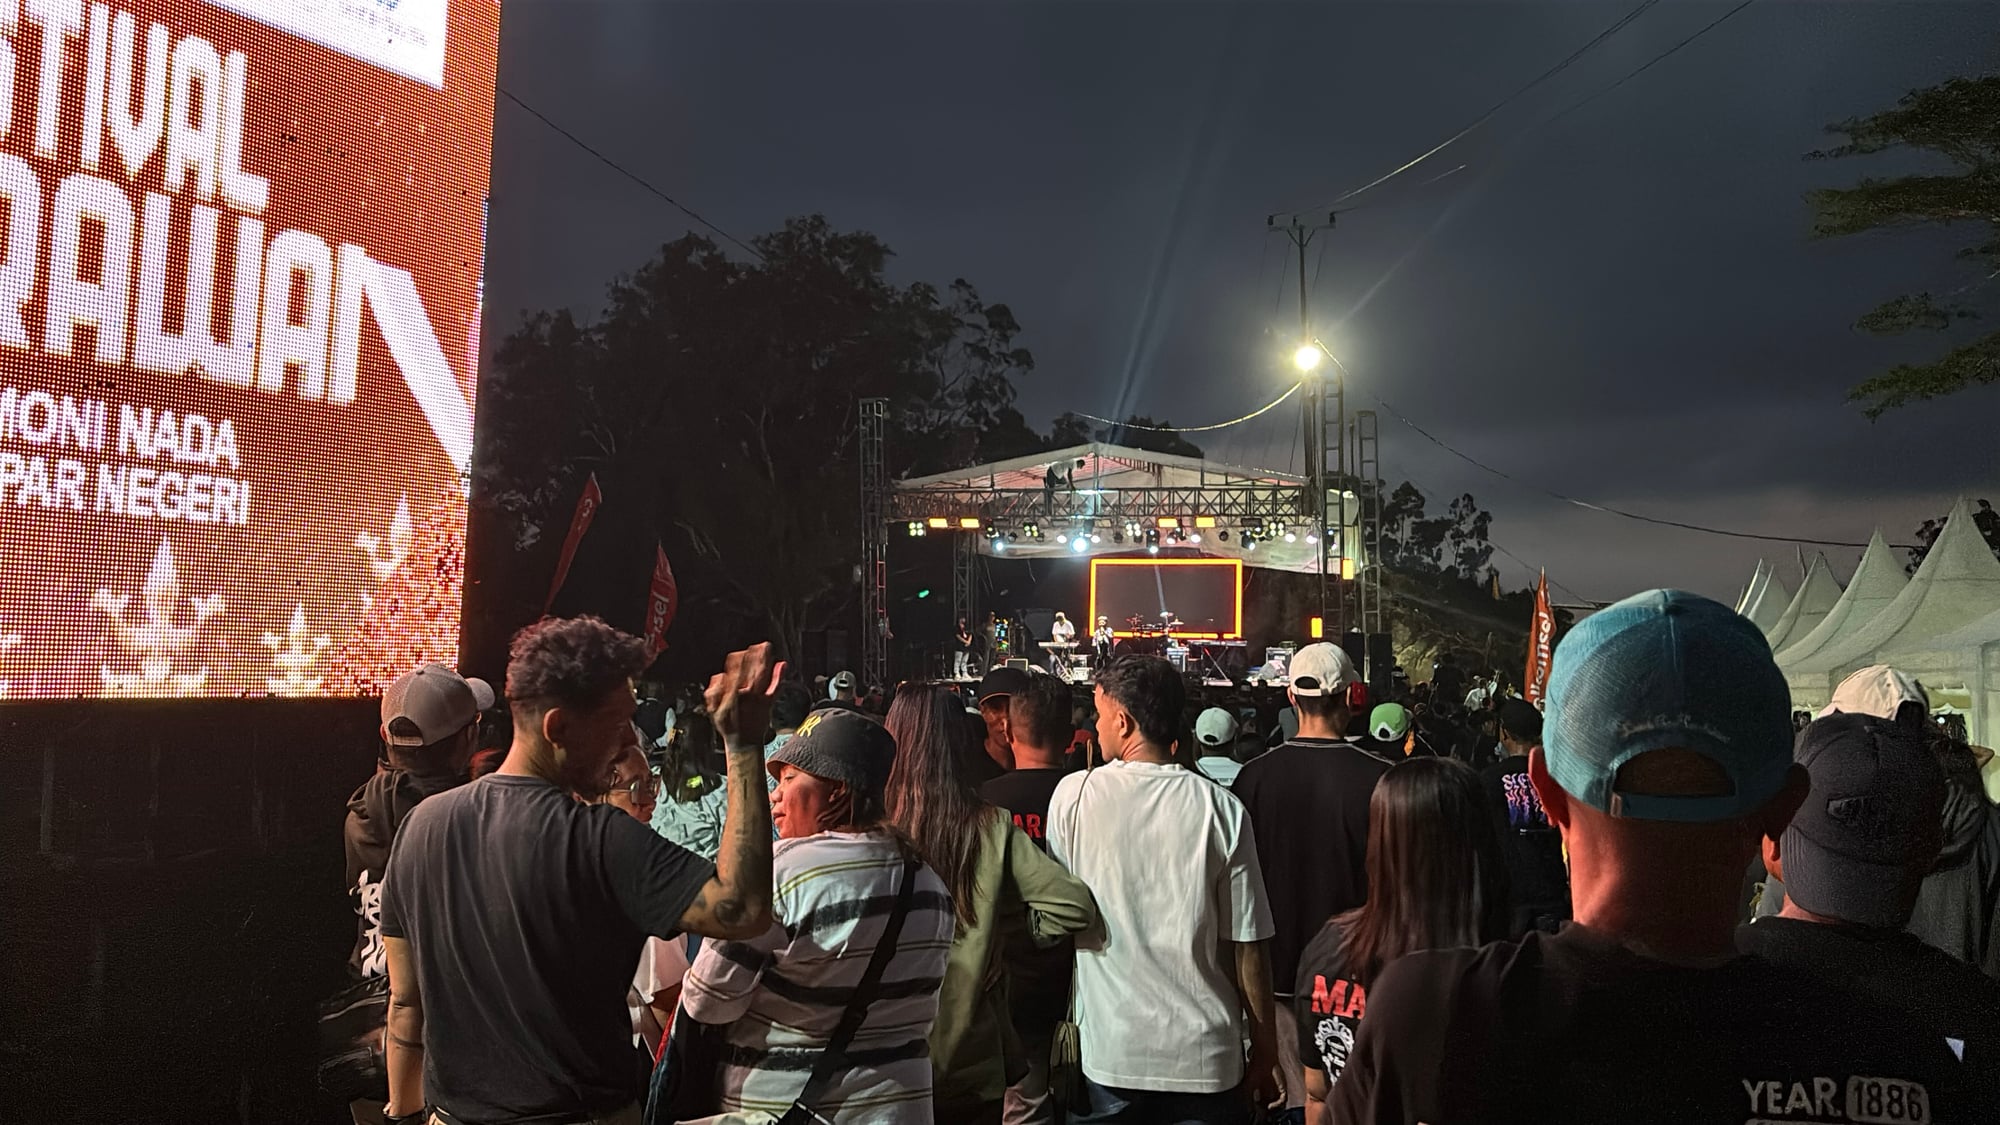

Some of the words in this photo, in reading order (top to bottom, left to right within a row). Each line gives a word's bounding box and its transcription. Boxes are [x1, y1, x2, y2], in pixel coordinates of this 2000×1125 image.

[118, 403, 240, 471] NADA
[95, 463, 250, 526] NEGERI
[1529, 611, 1552, 718] elkomsel
[1013, 813, 1048, 840] AR
[1854, 1081, 1924, 1121] 1886
